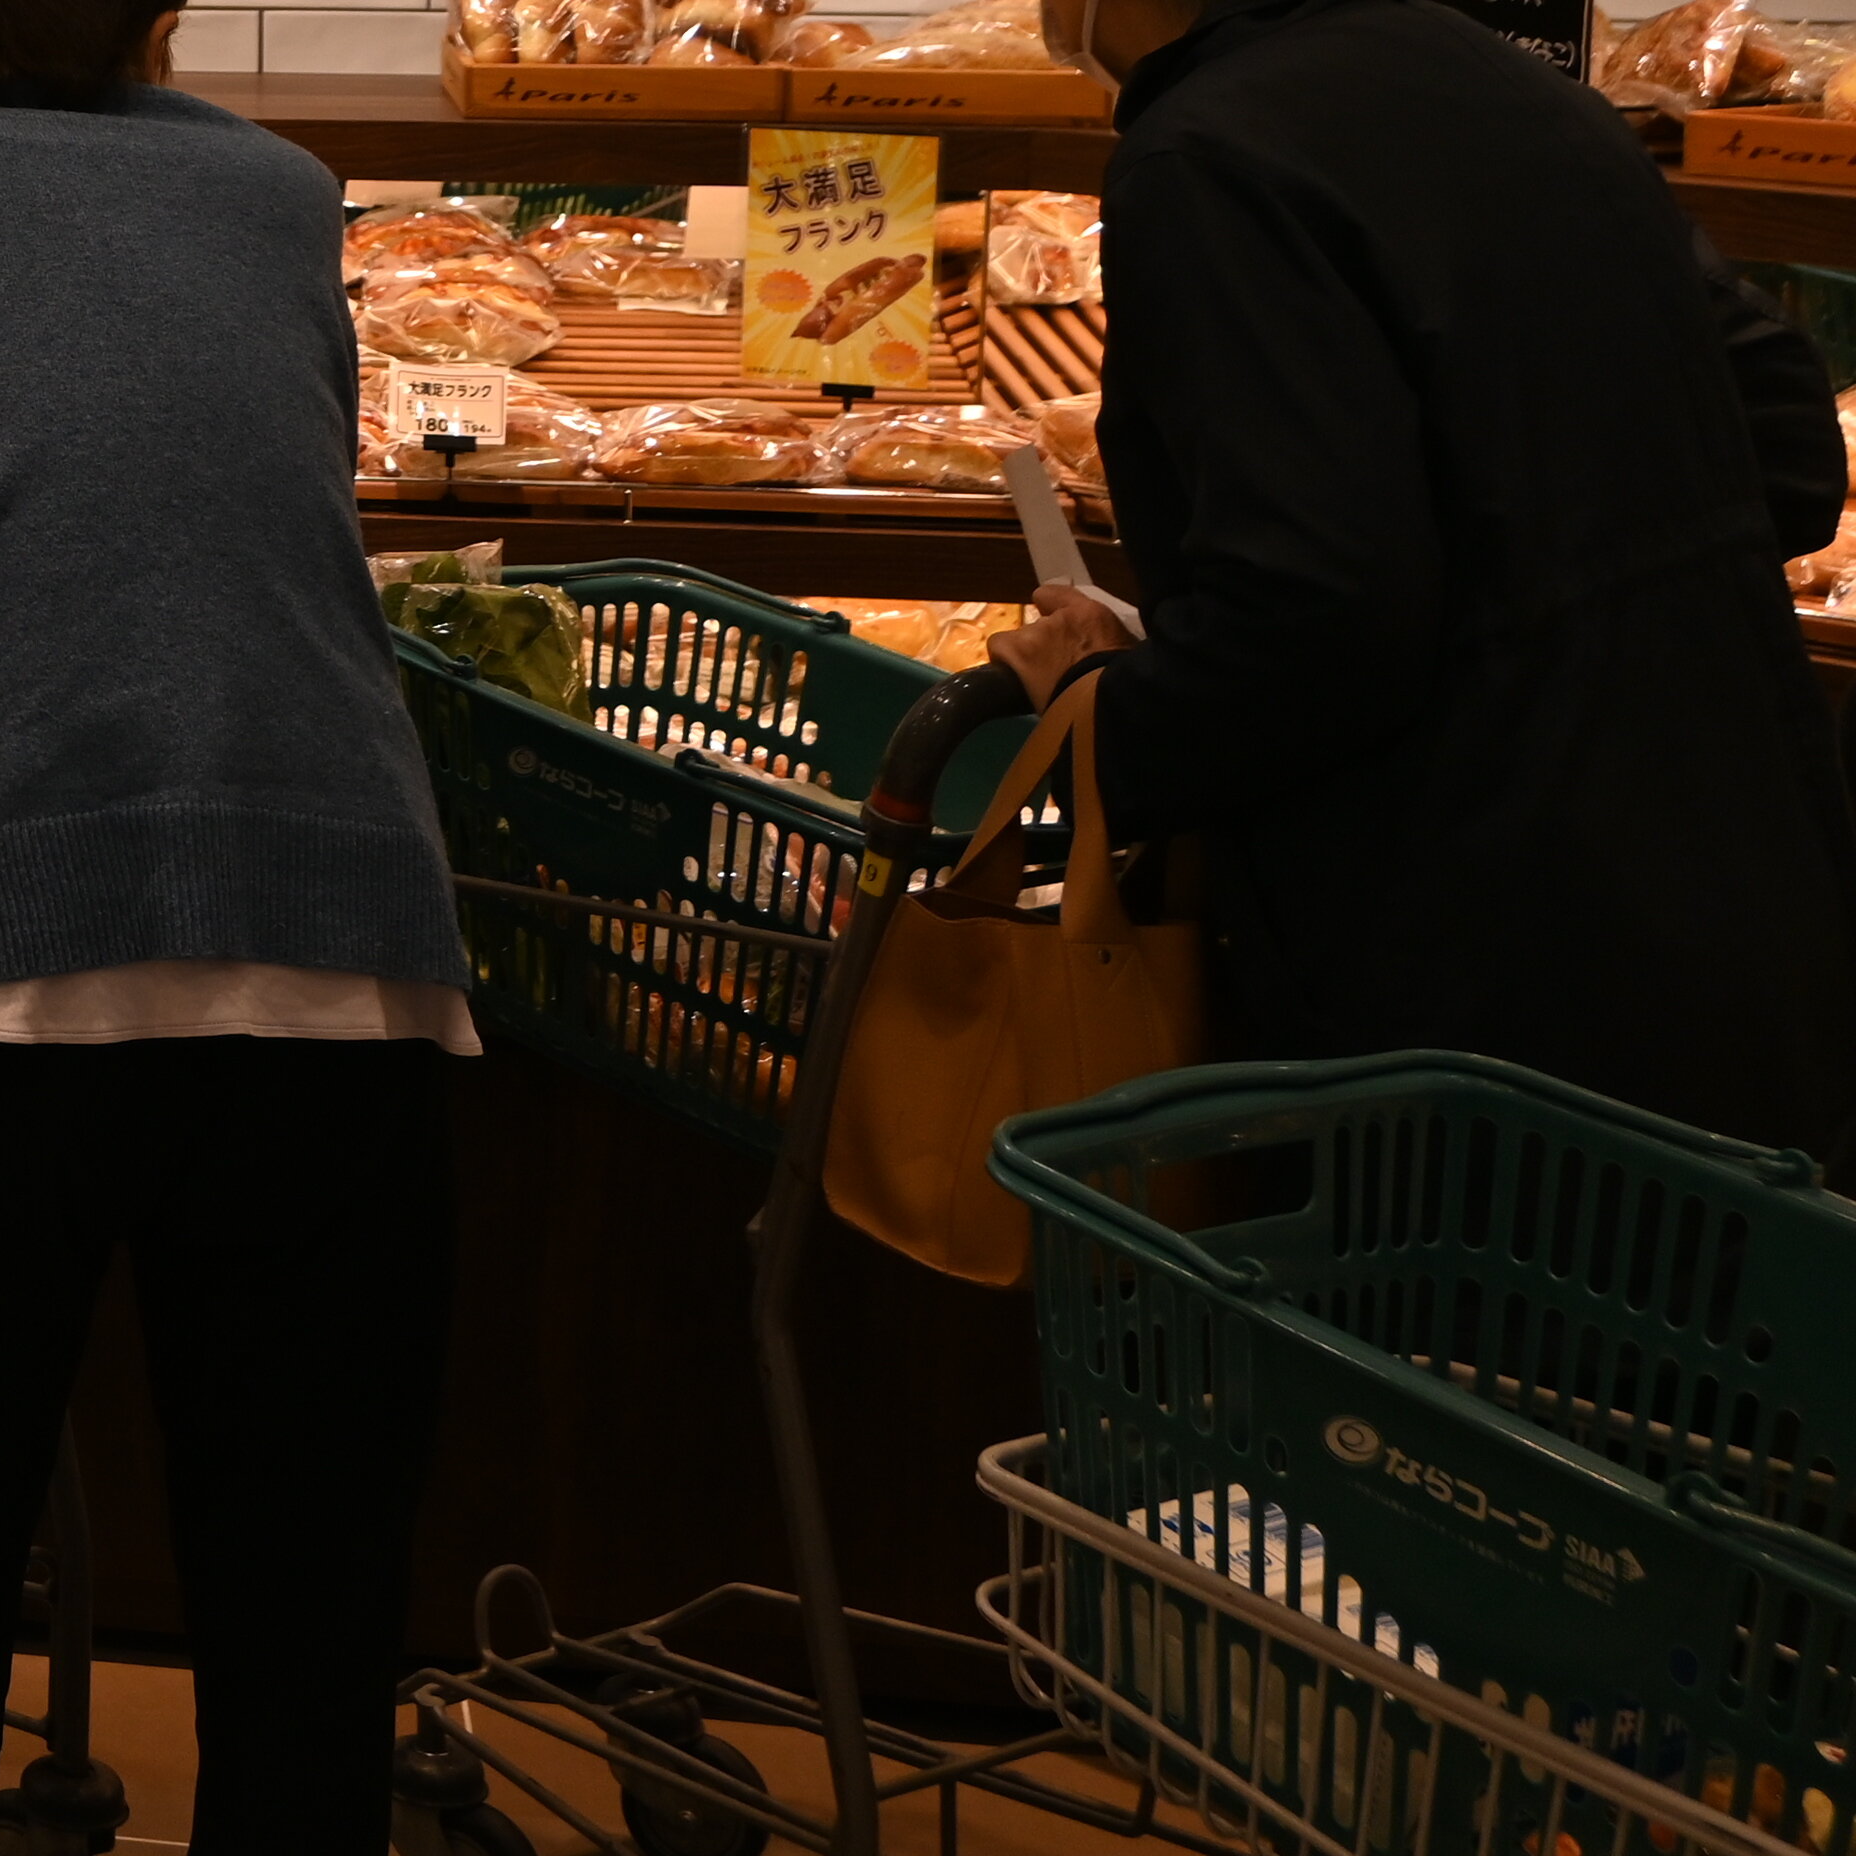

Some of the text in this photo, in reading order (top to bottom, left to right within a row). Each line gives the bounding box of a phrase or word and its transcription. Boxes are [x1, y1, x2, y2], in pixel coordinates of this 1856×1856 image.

[762, 158, 884, 216] 大満足
[780, 210, 886, 254] フランク
[408, 380, 492, 398] 大満足フランク
[1384, 1446, 1558, 1552] ならコープ
[1562, 1534, 1618, 1580] SIAA
